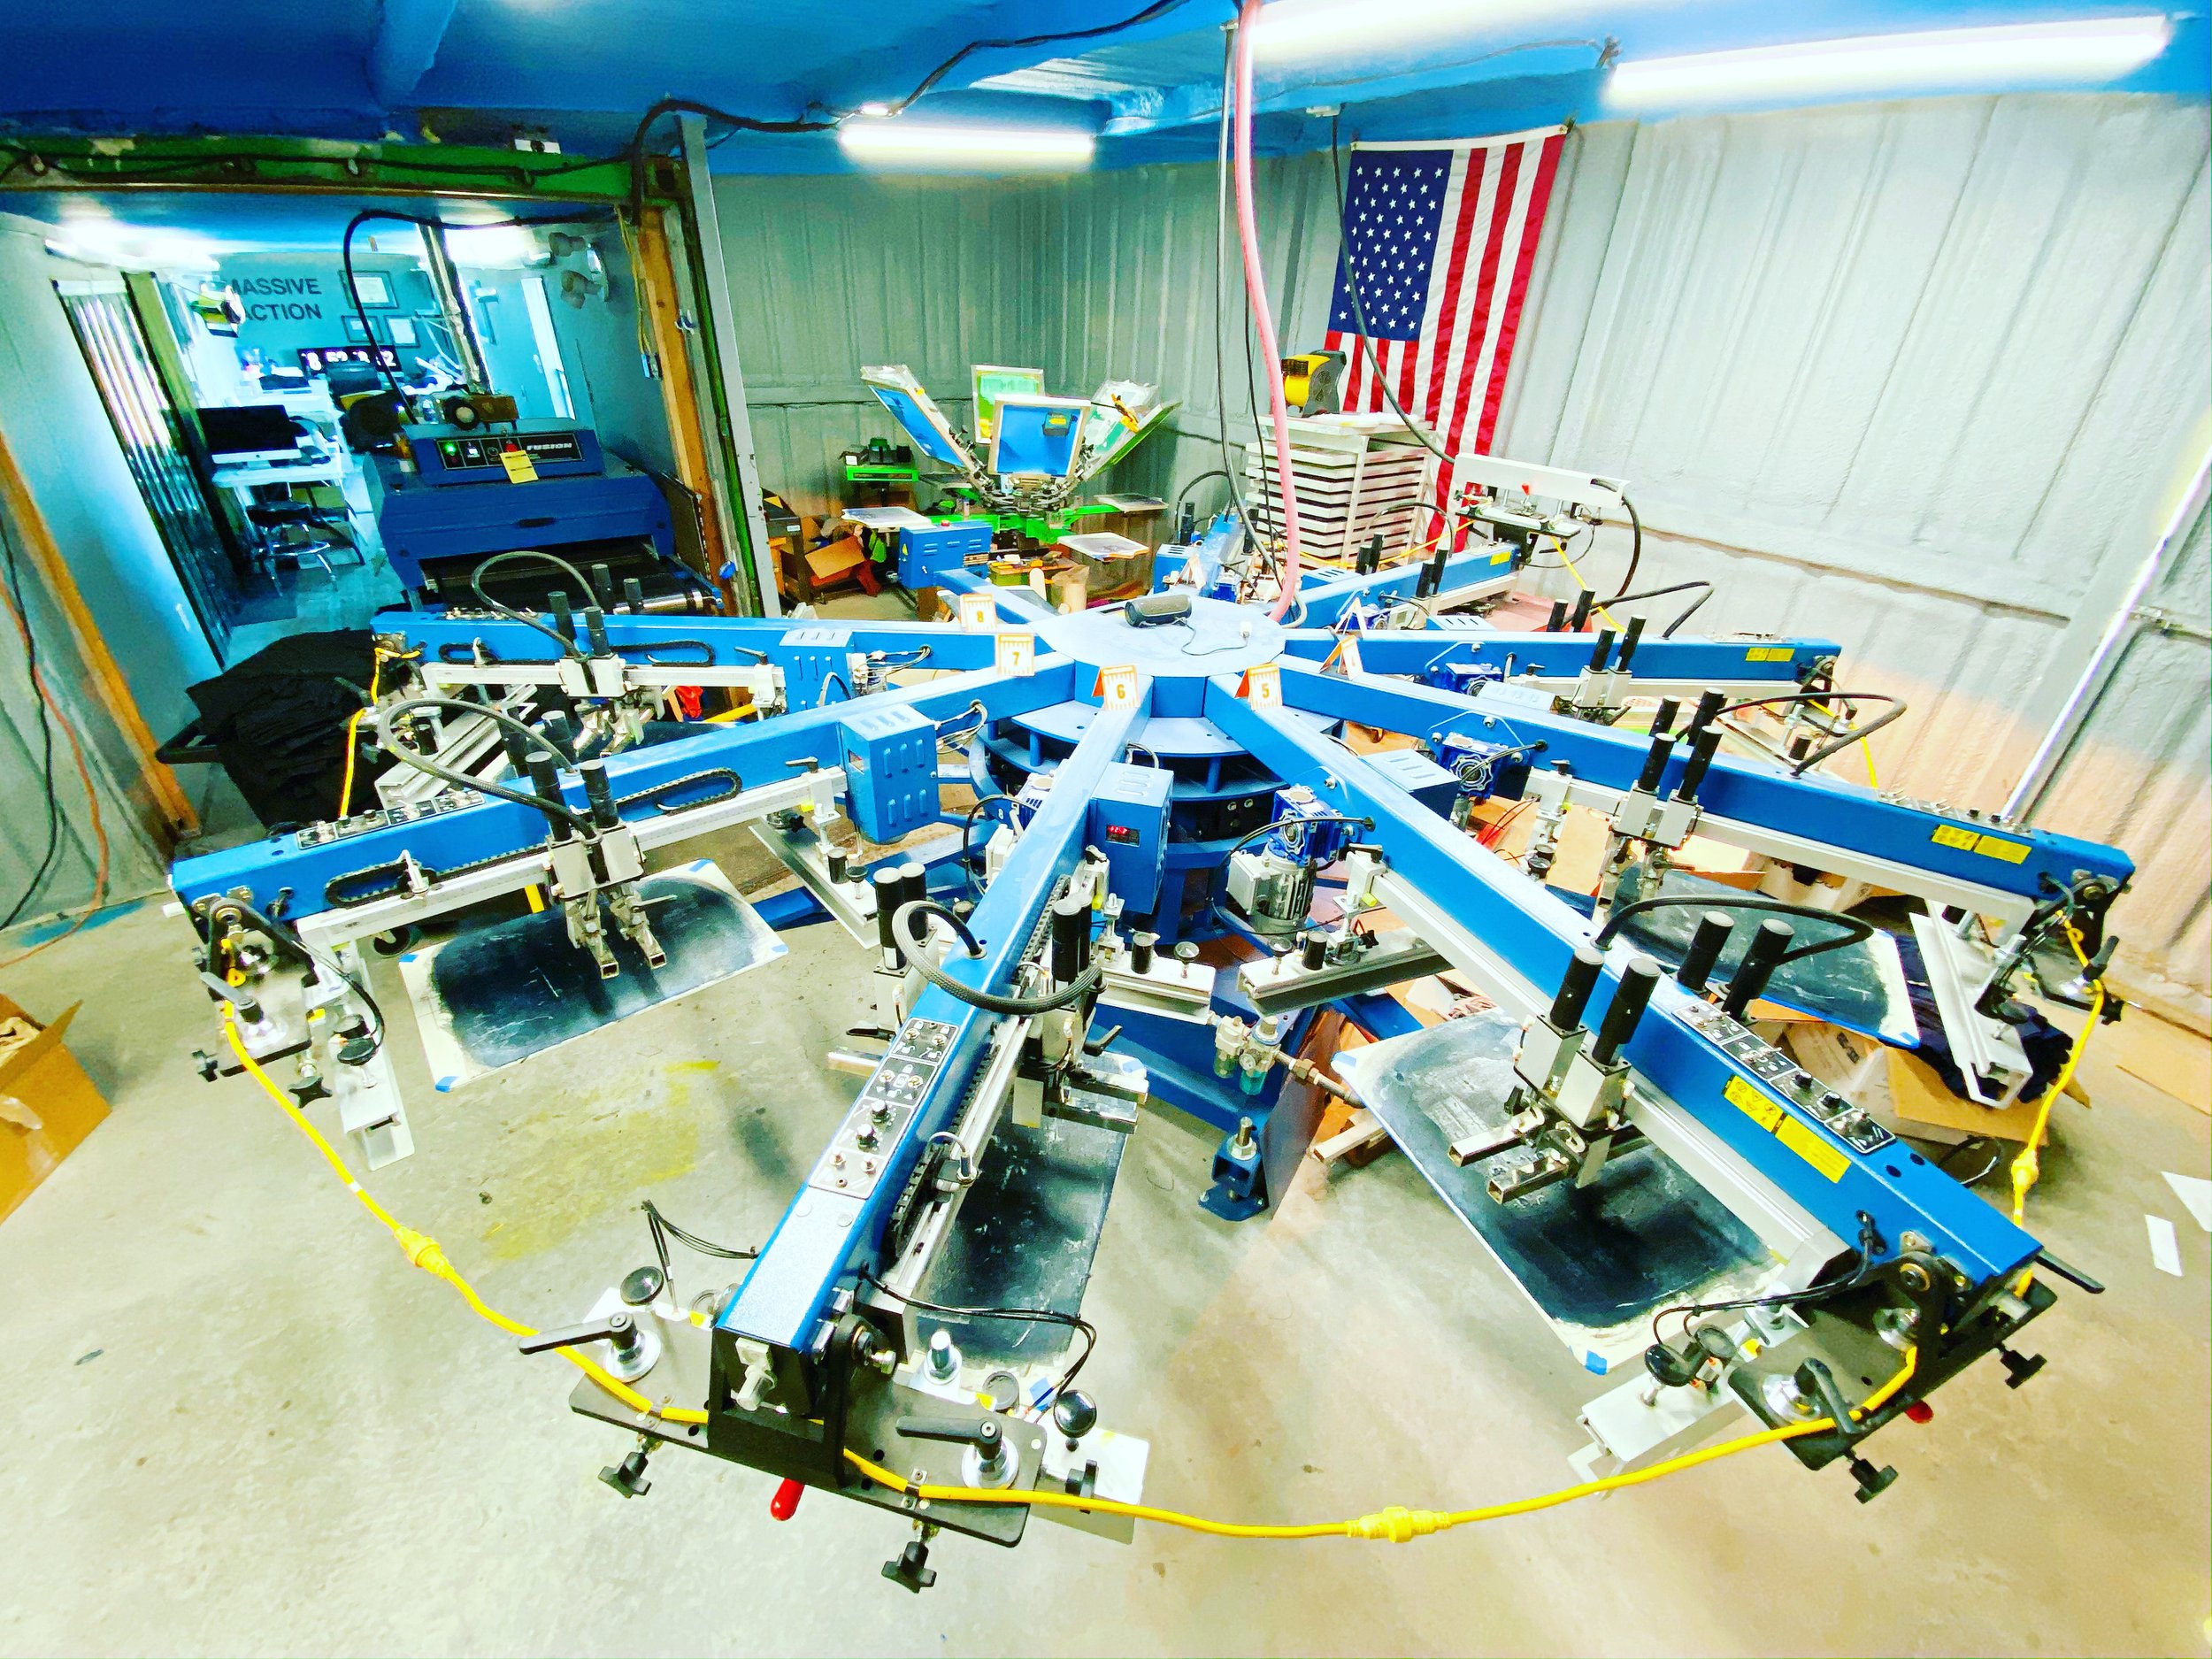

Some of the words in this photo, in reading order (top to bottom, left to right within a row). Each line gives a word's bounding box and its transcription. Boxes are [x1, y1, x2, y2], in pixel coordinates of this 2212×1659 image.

[526, 442, 572, 451] FUSION
[976, 610, 985, 624] 8
[1012, 651, 1020, 666] 7
[1116, 683, 1126, 700] 6
[1261, 682, 1270, 699] 5
